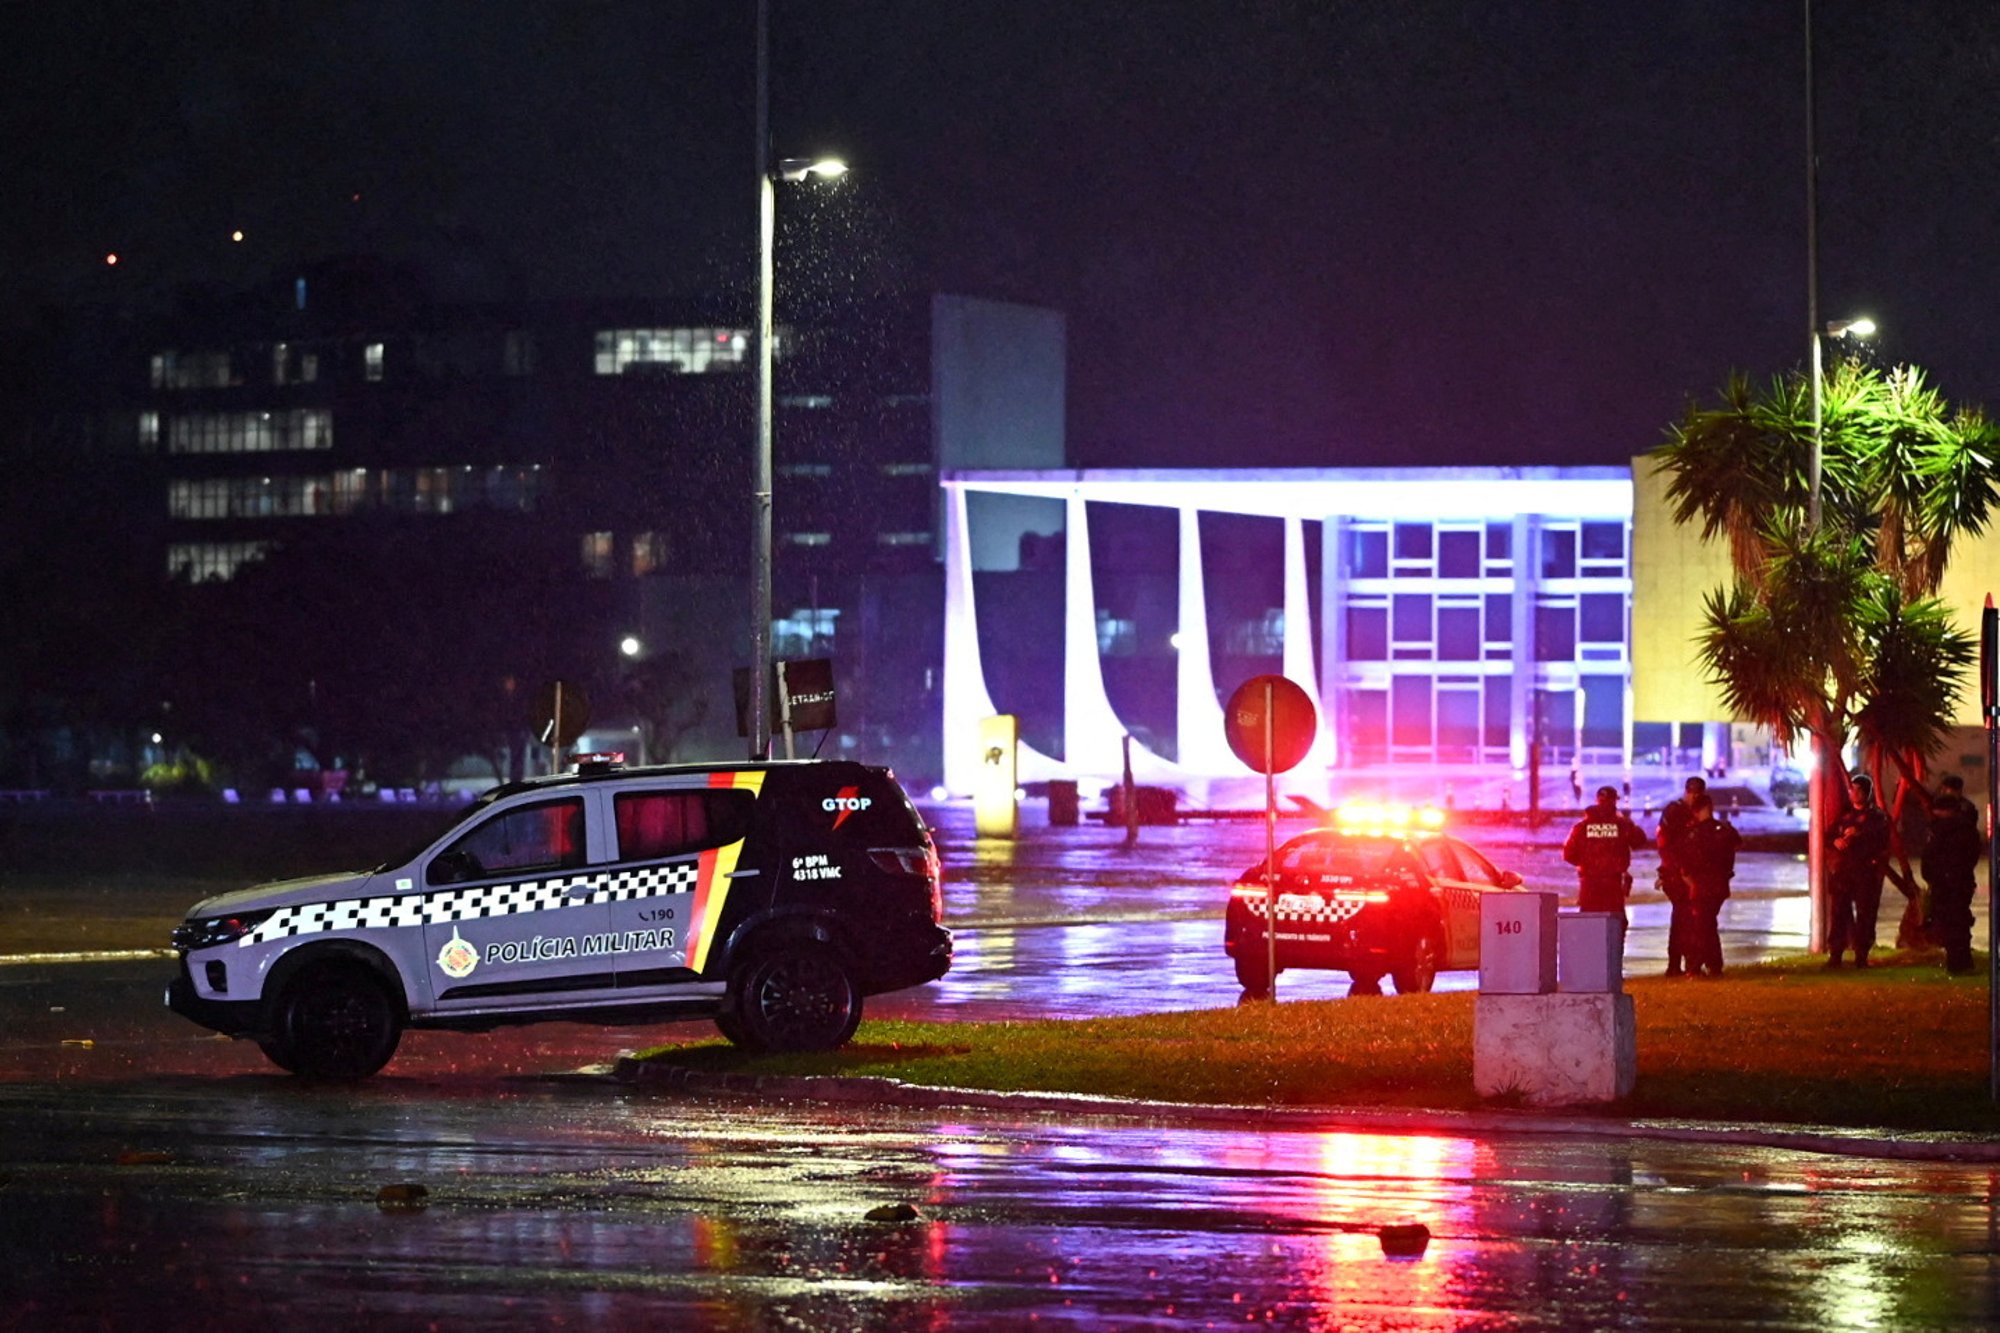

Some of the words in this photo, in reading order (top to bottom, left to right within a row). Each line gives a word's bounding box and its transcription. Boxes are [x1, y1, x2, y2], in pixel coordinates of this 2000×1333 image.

[822, 797, 872, 811] GTOP
[1586, 830, 1619, 838] MILITAR
[805, 854, 828, 868] BPM
[793, 868, 819, 881] 4318
[819, 866, 842, 879] VMC
[650, 908, 675, 921] 190
[1496, 920, 1522, 935] 140
[485, 935, 577, 965] POLÍCIA
[581, 928, 675, 955] MILITAR
